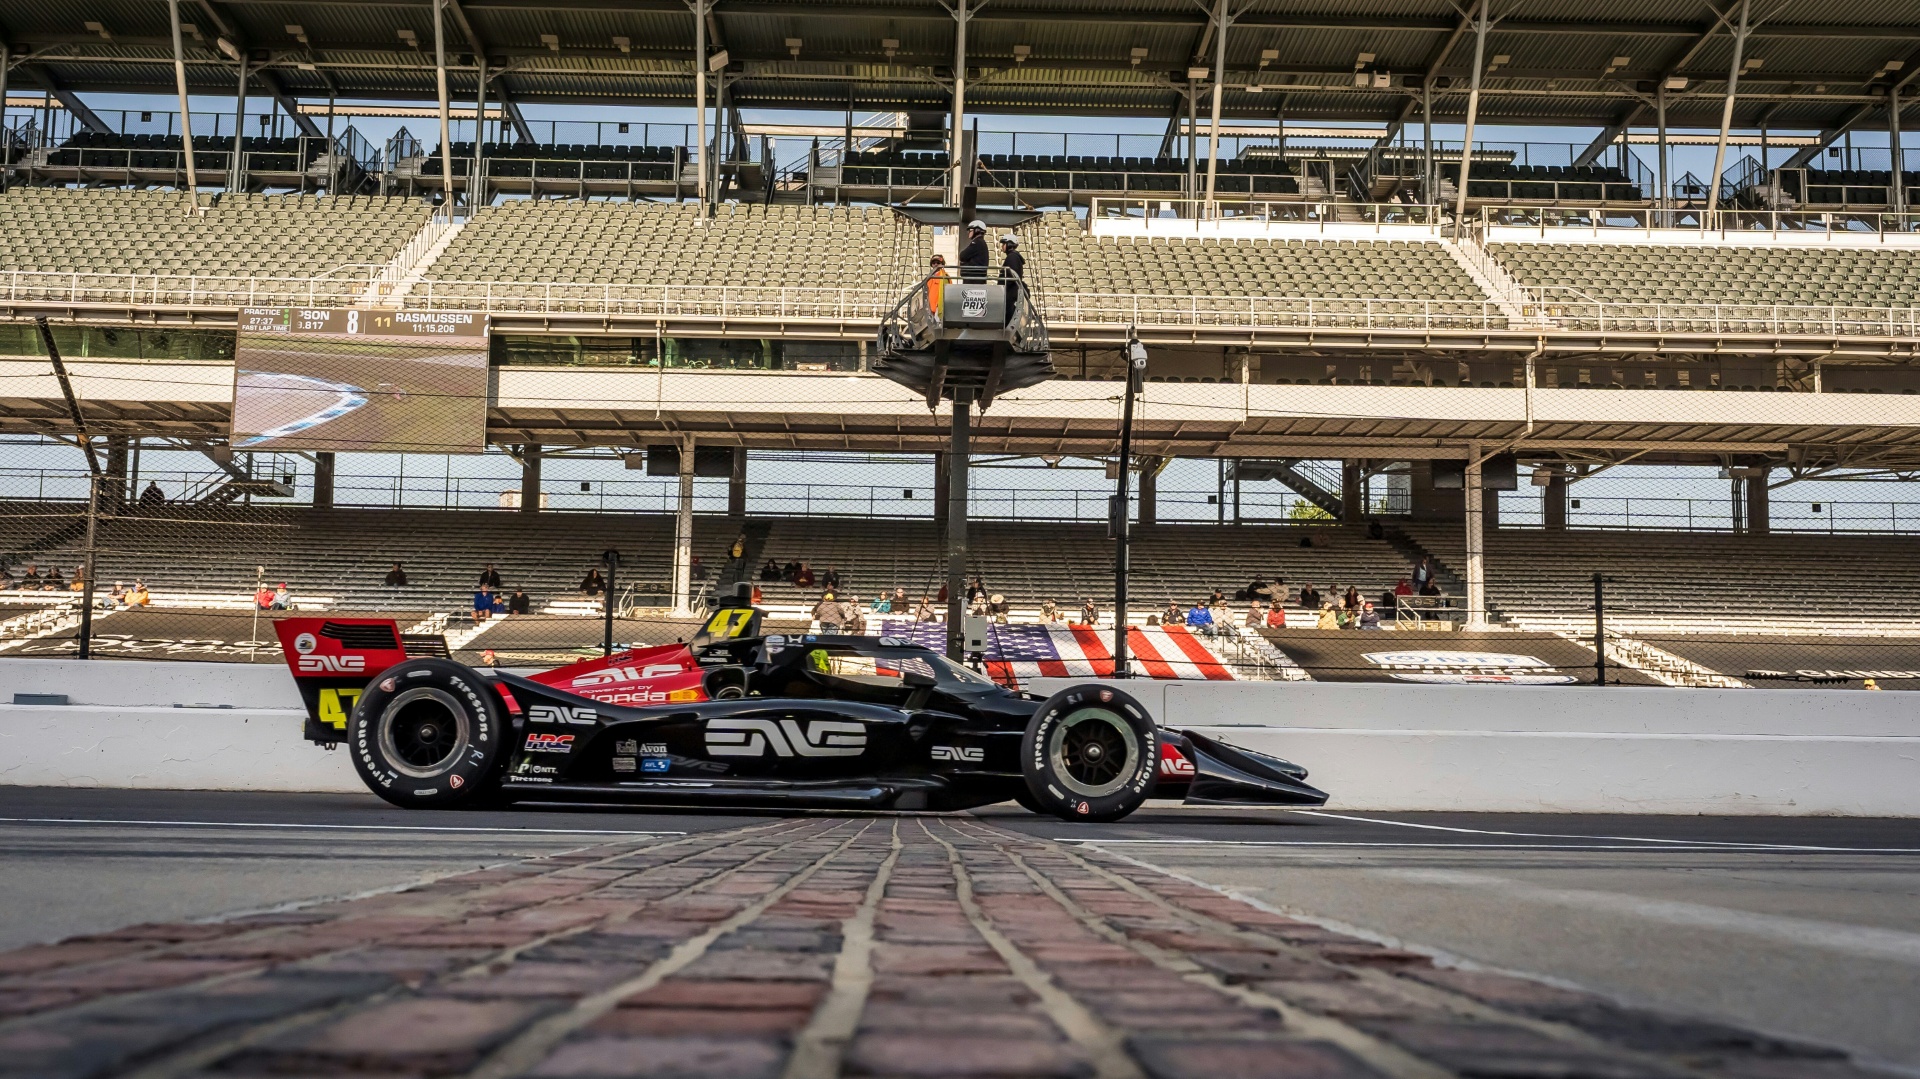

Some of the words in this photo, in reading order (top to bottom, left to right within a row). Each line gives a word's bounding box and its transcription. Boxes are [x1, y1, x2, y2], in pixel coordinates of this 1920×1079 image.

[243, 308, 281, 316] PRACTICE
[963, 301, 986, 310] PRIX
[249, 317, 274, 325] 27:37
[374, 316, 391, 328] 11
[395, 312, 473, 324] RASMUSSEN
[412, 323, 455, 333] 11:15.206
[707, 608, 755, 638] 47
[450, 675, 489, 742] Firestone
[524, 733, 576, 750] HRC
[1034, 708, 1059, 771] Firestone
[357, 719, 393, 789] Firestone
[639, 743, 668, 753] Avon
[1133, 731, 1155, 794] Firestone
[509, 775, 553, 783] Firestone
